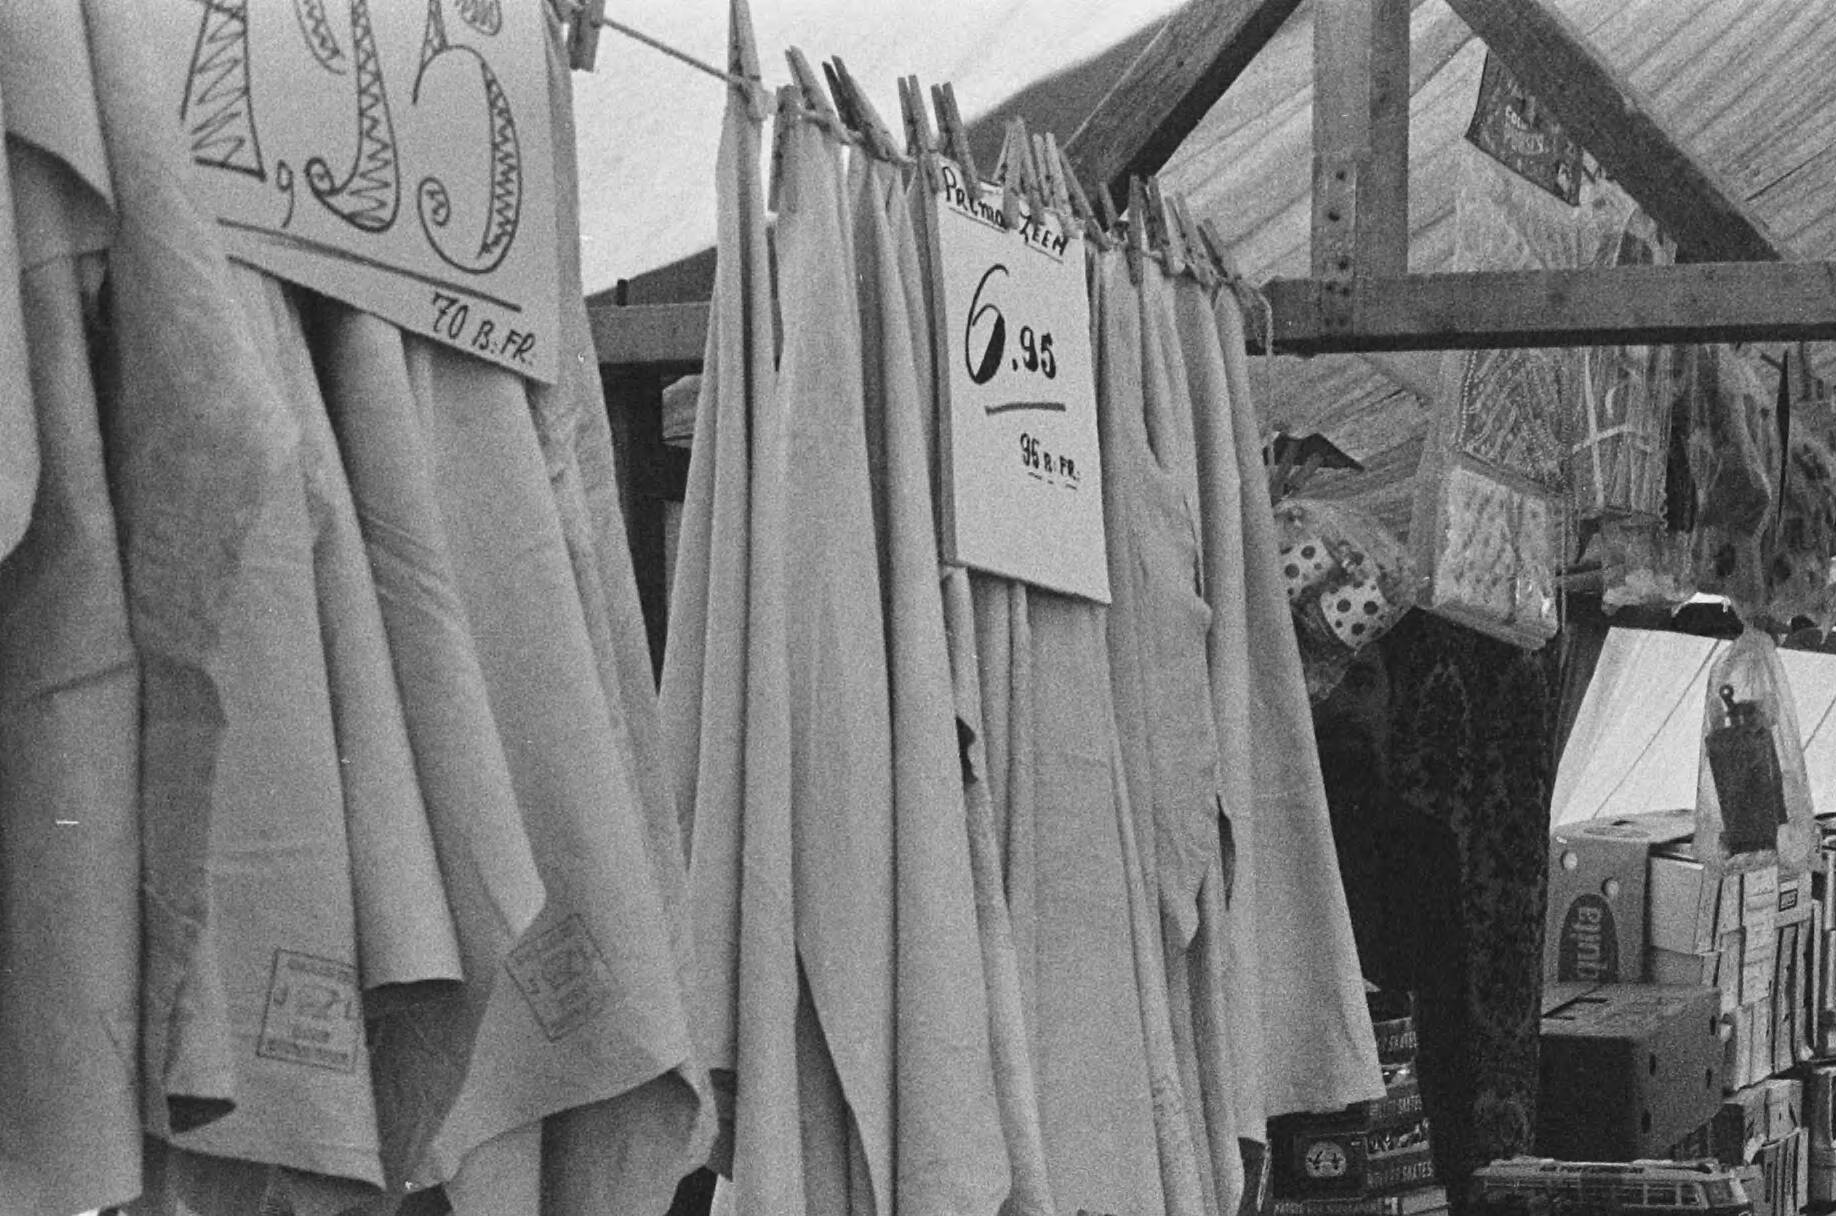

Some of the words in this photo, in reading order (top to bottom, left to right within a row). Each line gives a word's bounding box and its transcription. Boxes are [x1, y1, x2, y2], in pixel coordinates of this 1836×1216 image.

[432, 291, 468, 340] 70
[965, 264, 1057, 385] 6.95
[1020, 433, 1040, 469] 95
